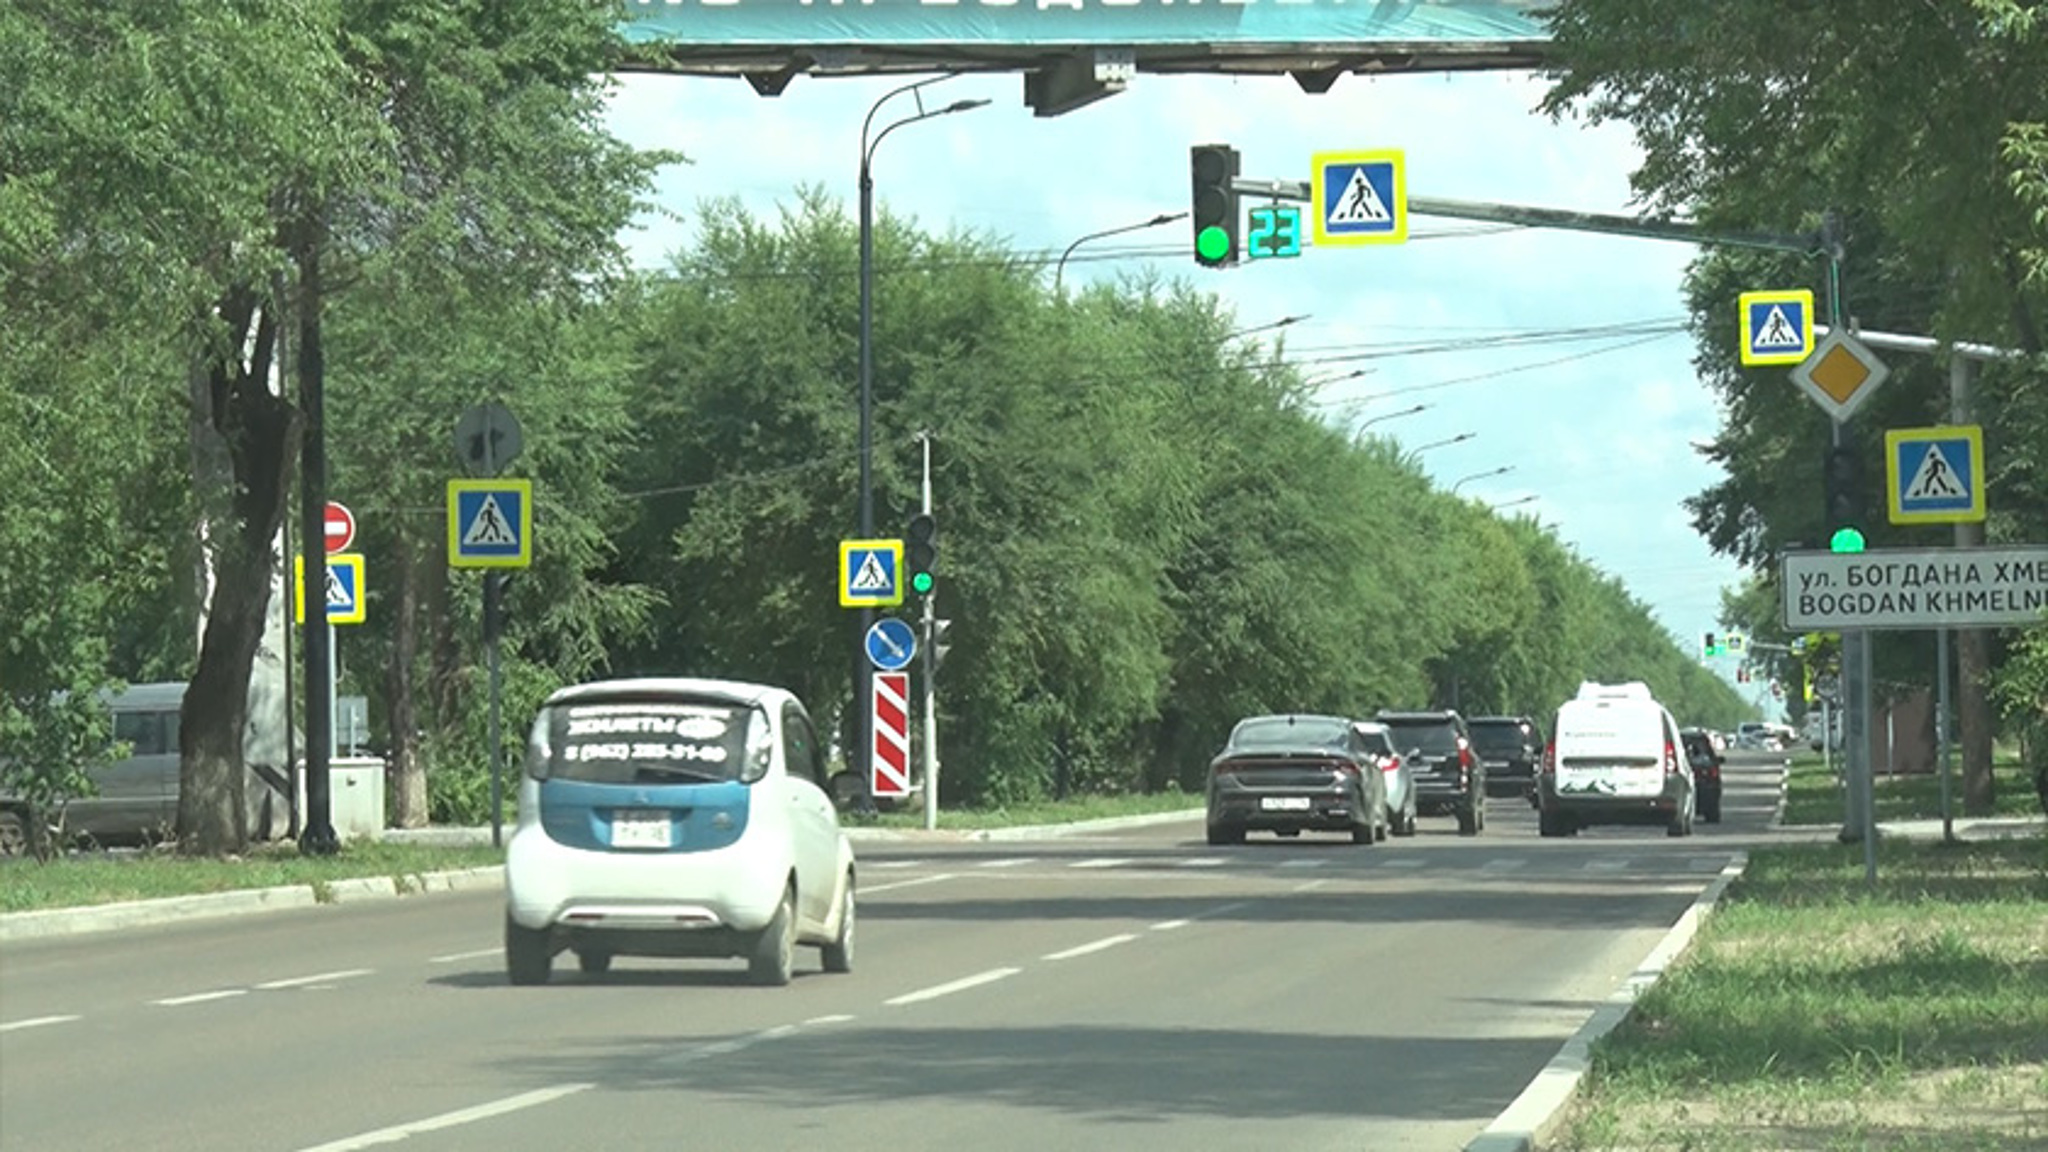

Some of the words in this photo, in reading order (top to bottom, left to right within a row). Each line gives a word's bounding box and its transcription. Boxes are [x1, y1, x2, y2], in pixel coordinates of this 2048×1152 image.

[1249, 209, 1300, 257] 23
[1798, 572, 1838, 592] ул.
[1847, 564, 1981, 588] БОГДАНА
[1993, 561, 2048, 585] ХМЕ
[1798, 592, 1917, 616] BOGDAN
